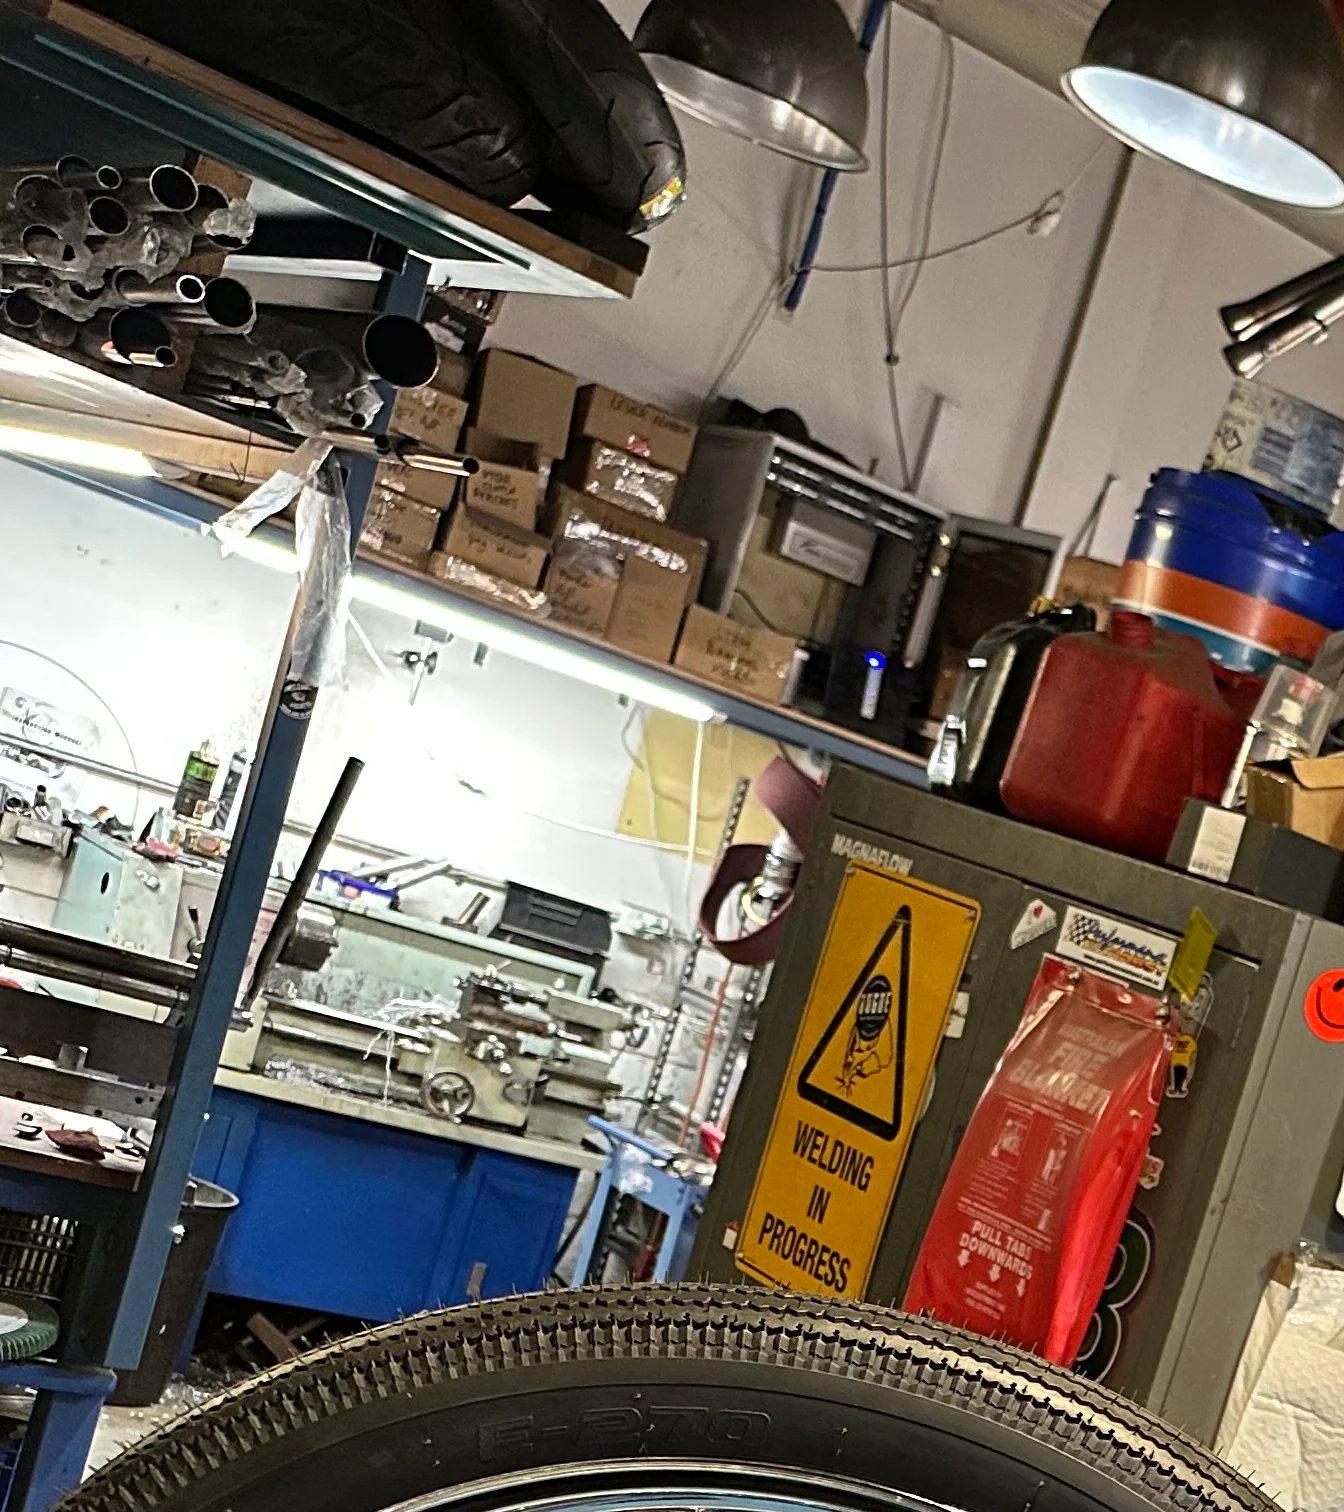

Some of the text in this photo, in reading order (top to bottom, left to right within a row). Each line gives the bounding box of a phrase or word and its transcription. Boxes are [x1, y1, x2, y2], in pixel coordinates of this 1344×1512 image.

[831, 833, 914, 876] MAGNAFLOW
[1051, 1042, 1111, 1076] FIRE
[1008, 1058, 1114, 1114] BLANKET
[792, 1120, 875, 1192] WELDING
[806, 1184, 831, 1224] IN
[757, 1212, 852, 1293] PROGRESS
[959, 1232, 1034, 1281] DOWNWARDS
[970, 1220, 1002, 1246] PULL
[1006, 1234, 1033, 1260] TABS
